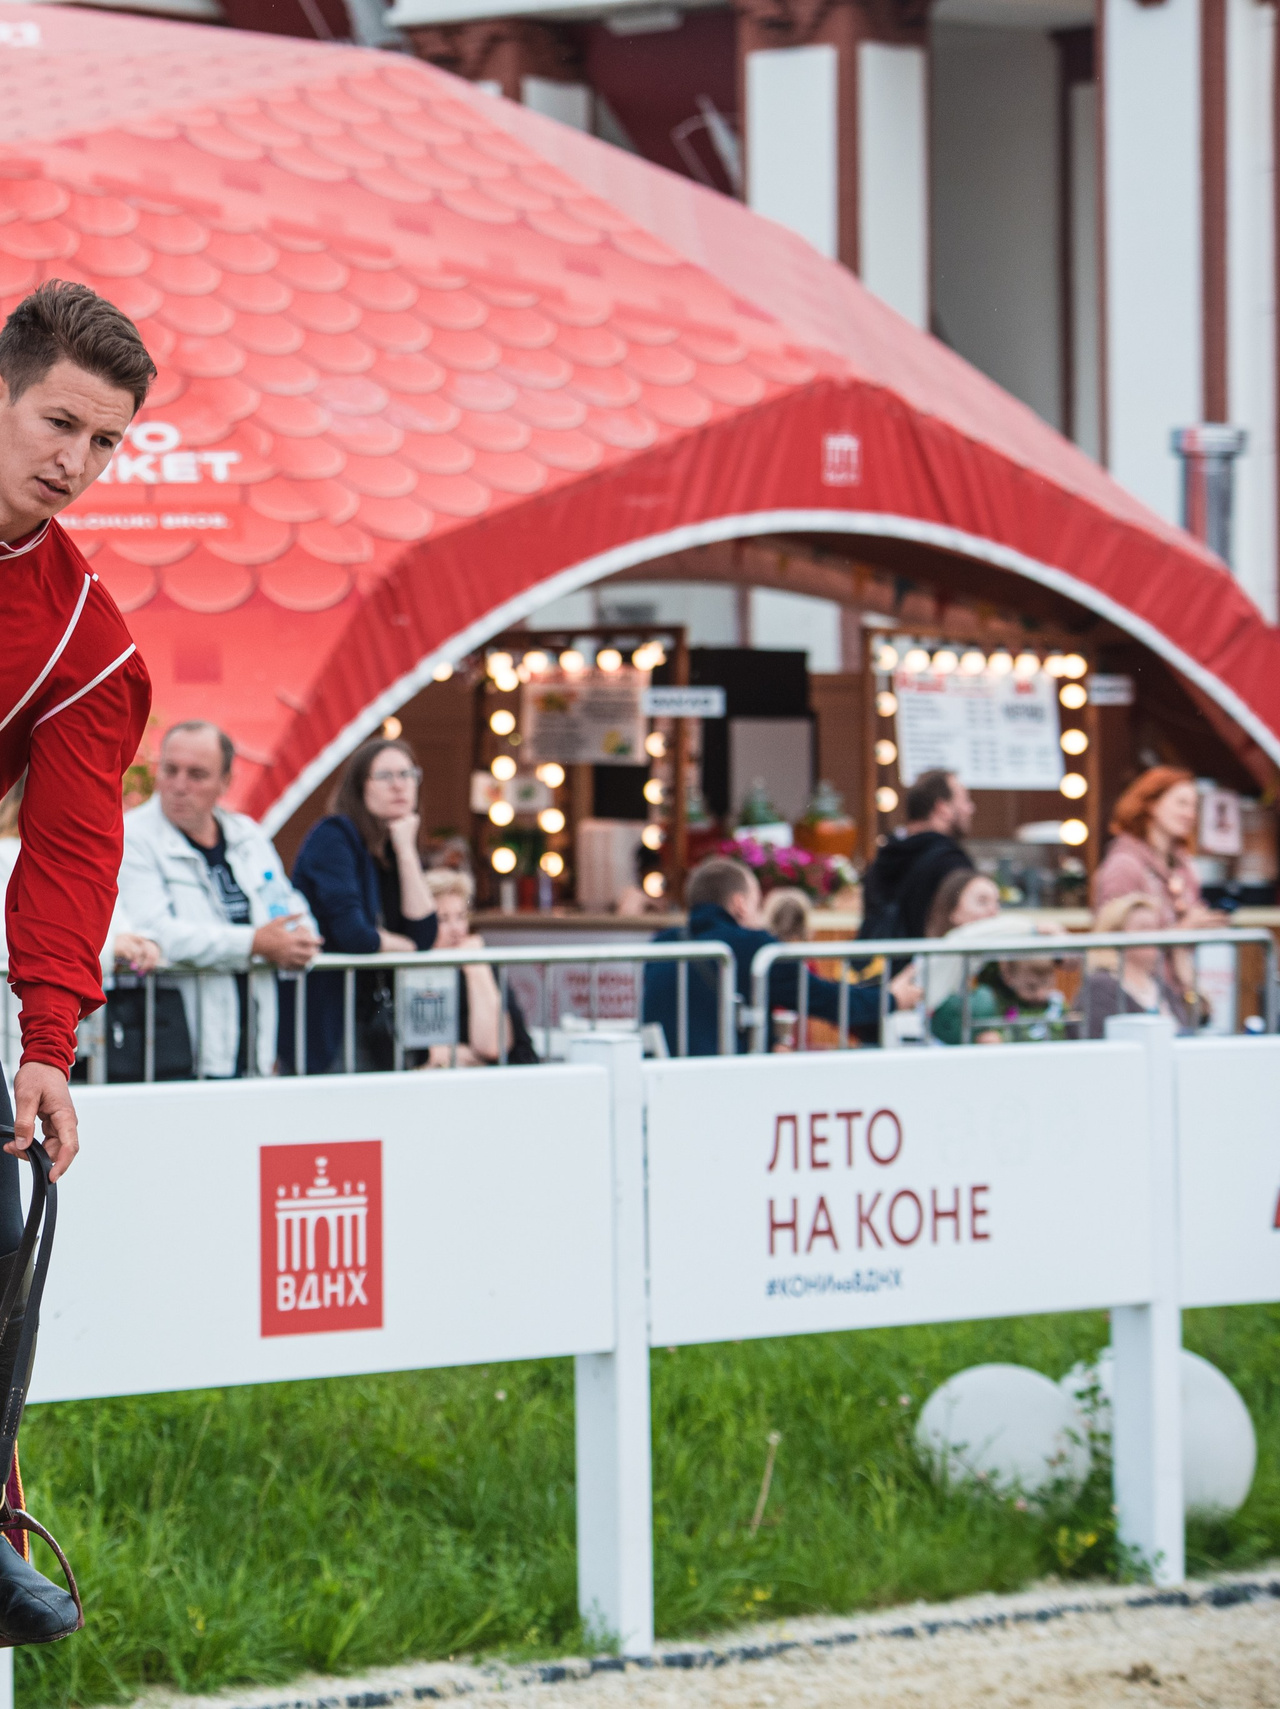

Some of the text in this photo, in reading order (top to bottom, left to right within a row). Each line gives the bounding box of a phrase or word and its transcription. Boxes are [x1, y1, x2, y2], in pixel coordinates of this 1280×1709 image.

[125, 421, 181, 452] O
[767, 1109, 903, 1172] ЛЕТО
[768, 1185, 991, 1256] НА КОНЕ
[276, 1269, 369, 1312] ВДНХ
